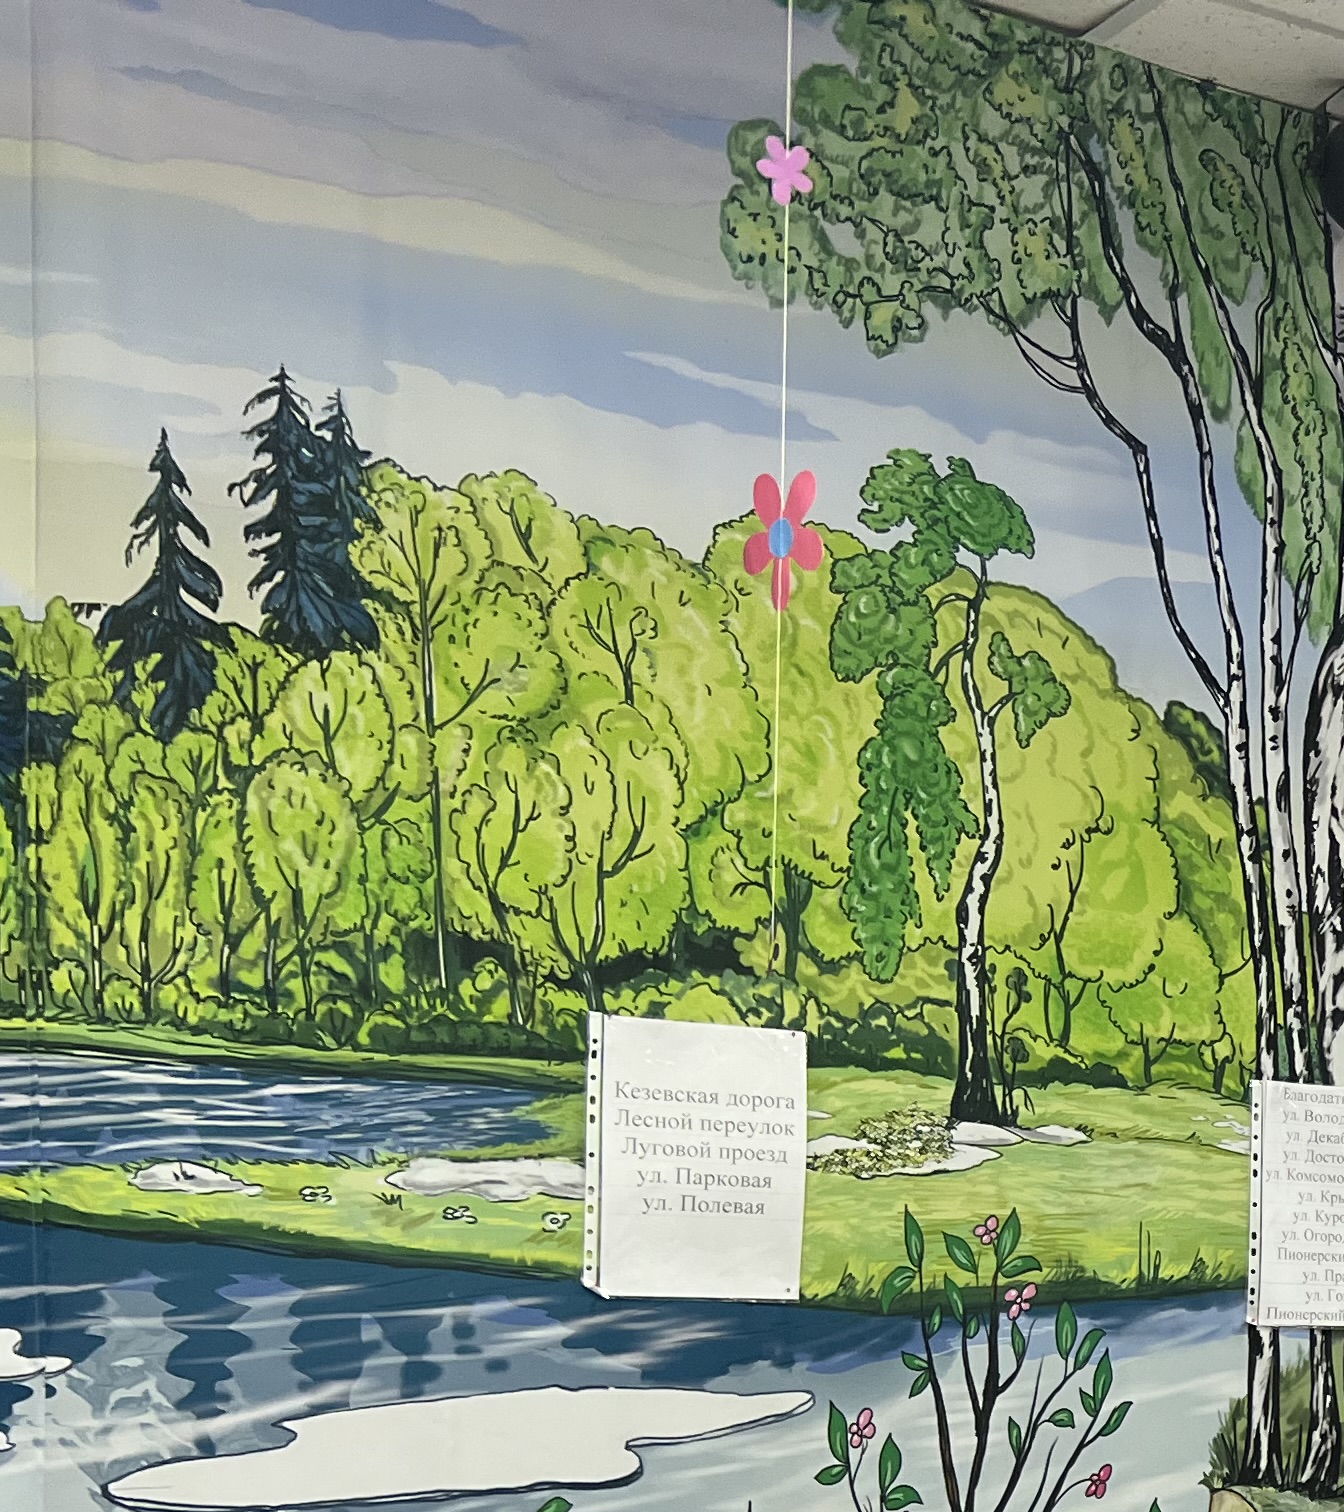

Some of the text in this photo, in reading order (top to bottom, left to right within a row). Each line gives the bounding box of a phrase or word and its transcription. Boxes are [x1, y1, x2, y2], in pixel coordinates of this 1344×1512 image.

[614, 1081, 795, 1111] Кезевская дорога
[614, 1109, 795, 1137] Лесной переулок
[622, 1137, 788, 1165] Луговой проезд
[636, 1168, 772, 1189] ул. Парковая
[642, 1196, 765, 1215] ул. Полевая
[1267, 1307, 1344, 1323] Пионерский
